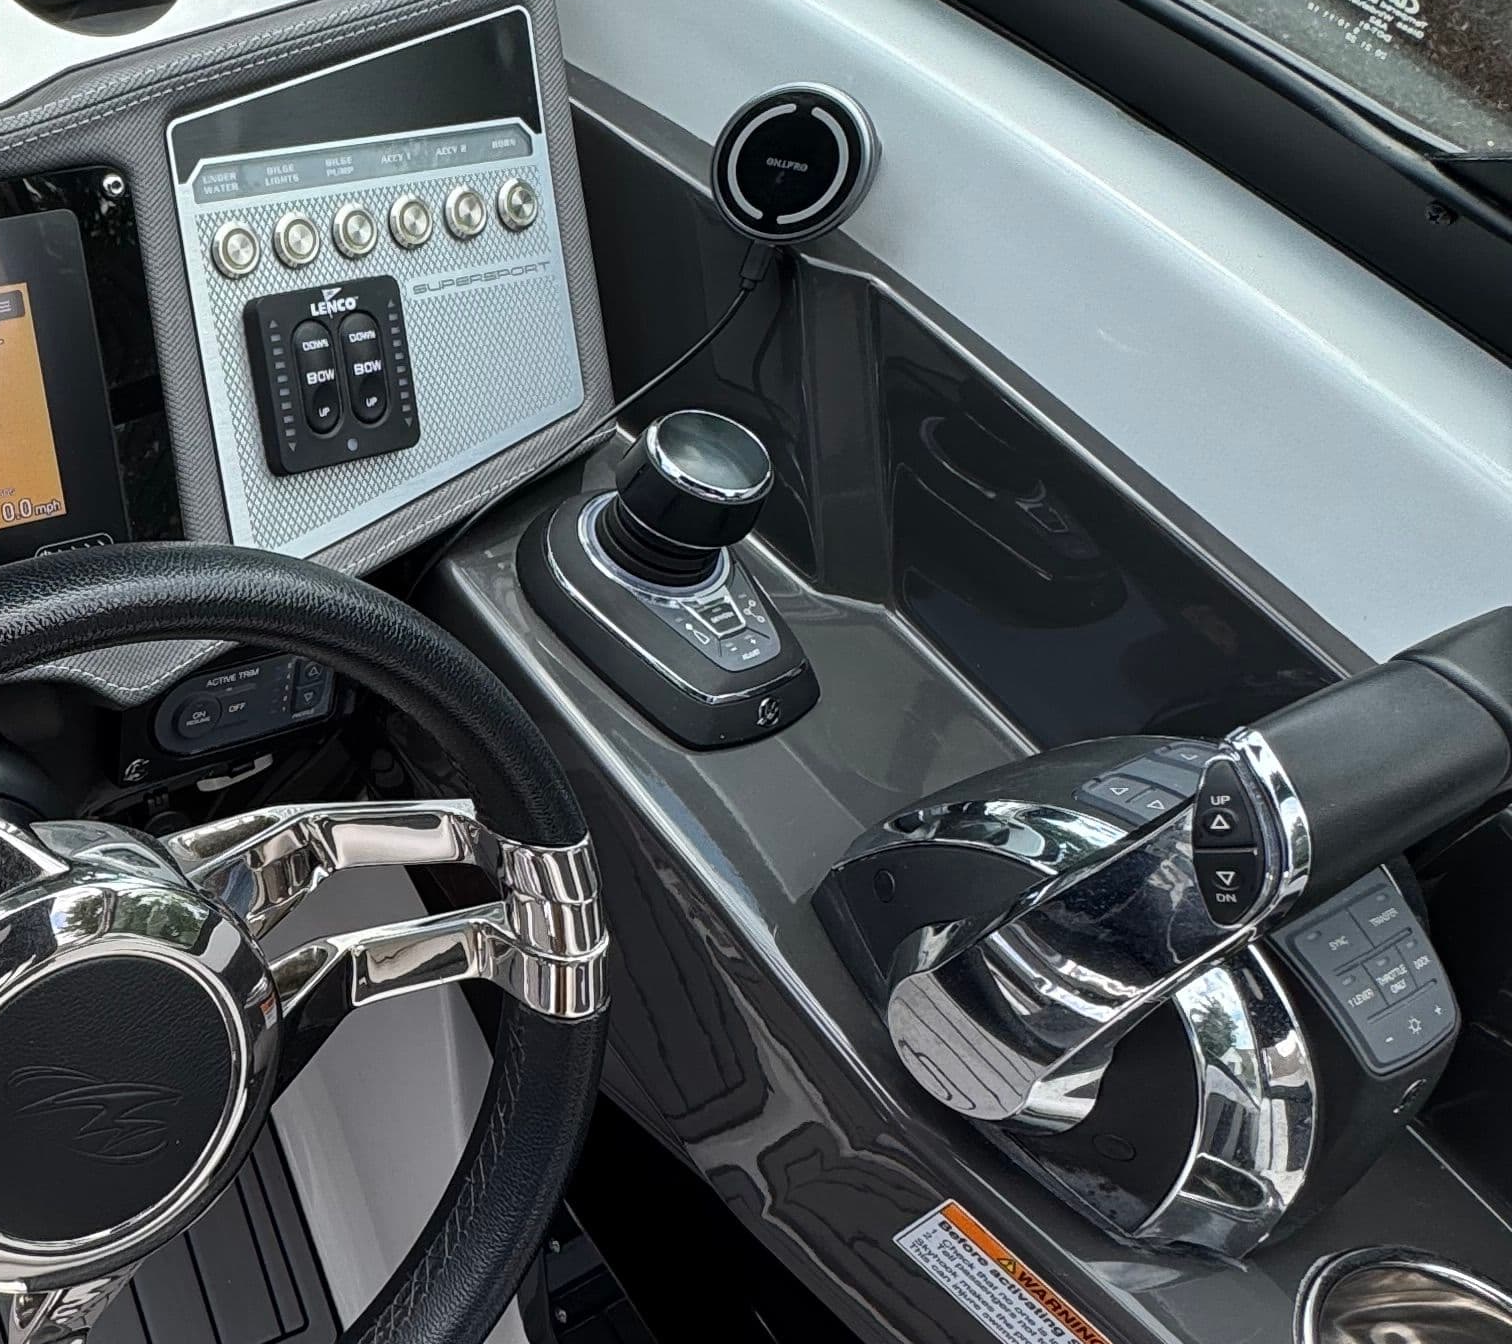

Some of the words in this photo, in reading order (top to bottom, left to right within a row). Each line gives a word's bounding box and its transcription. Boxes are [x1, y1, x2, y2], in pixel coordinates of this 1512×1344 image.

[201, 171, 237, 184] UNDER
[203, 183, 239, 195] WATER
[412, 261, 551, 296] SUPERSPORT
[310, 297, 357, 317] LENCO
[349, 329, 376, 343] DOWN
[302, 338, 329, 352] DOWN
[353, 359, 383, 376] BOW
[306, 368, 336, 385] BOW
[366, 396, 378, 408] UP
[318, 406, 331, 418] UP
[1, 498, 33, 523] 0.0
[34, 498, 62, 517] mph
[205, 672, 237, 687] ACTIVE
[238, 667, 261, 680] TRIM
[192, 710, 207, 720] ON
[228, 702, 247, 713] OFF
[1209, 794, 1231, 806] UP
[1215, 892, 1238, 904] DN
[1328, 935, 1350, 952] SYNC
[909, 1242, 930, 1263] This
[931, 1265, 951, 1282] can
[952, 1283, 981, 1310] injure
[912, 1238, 958, 1278] Skyhook
[959, 1280, 995, 1312] makes
[996, 1313, 1014, 1329] the
[938, 1220, 988, 1266] Before
[989, 1269, 1065, 1337] activating
[937, 1243, 957, 1262] Tell
[954, 1263, 1017, 1319] passengers
[1017, 1320, 1037, 1336] not
[940, 1239, 975, 1270] Check
[976, 1271, 998, 1290] that
[998, 1292, 1013, 1305] no
[1014, 1307, 1036, 1326] one
[1037, 1327, 1048, 1337] is
